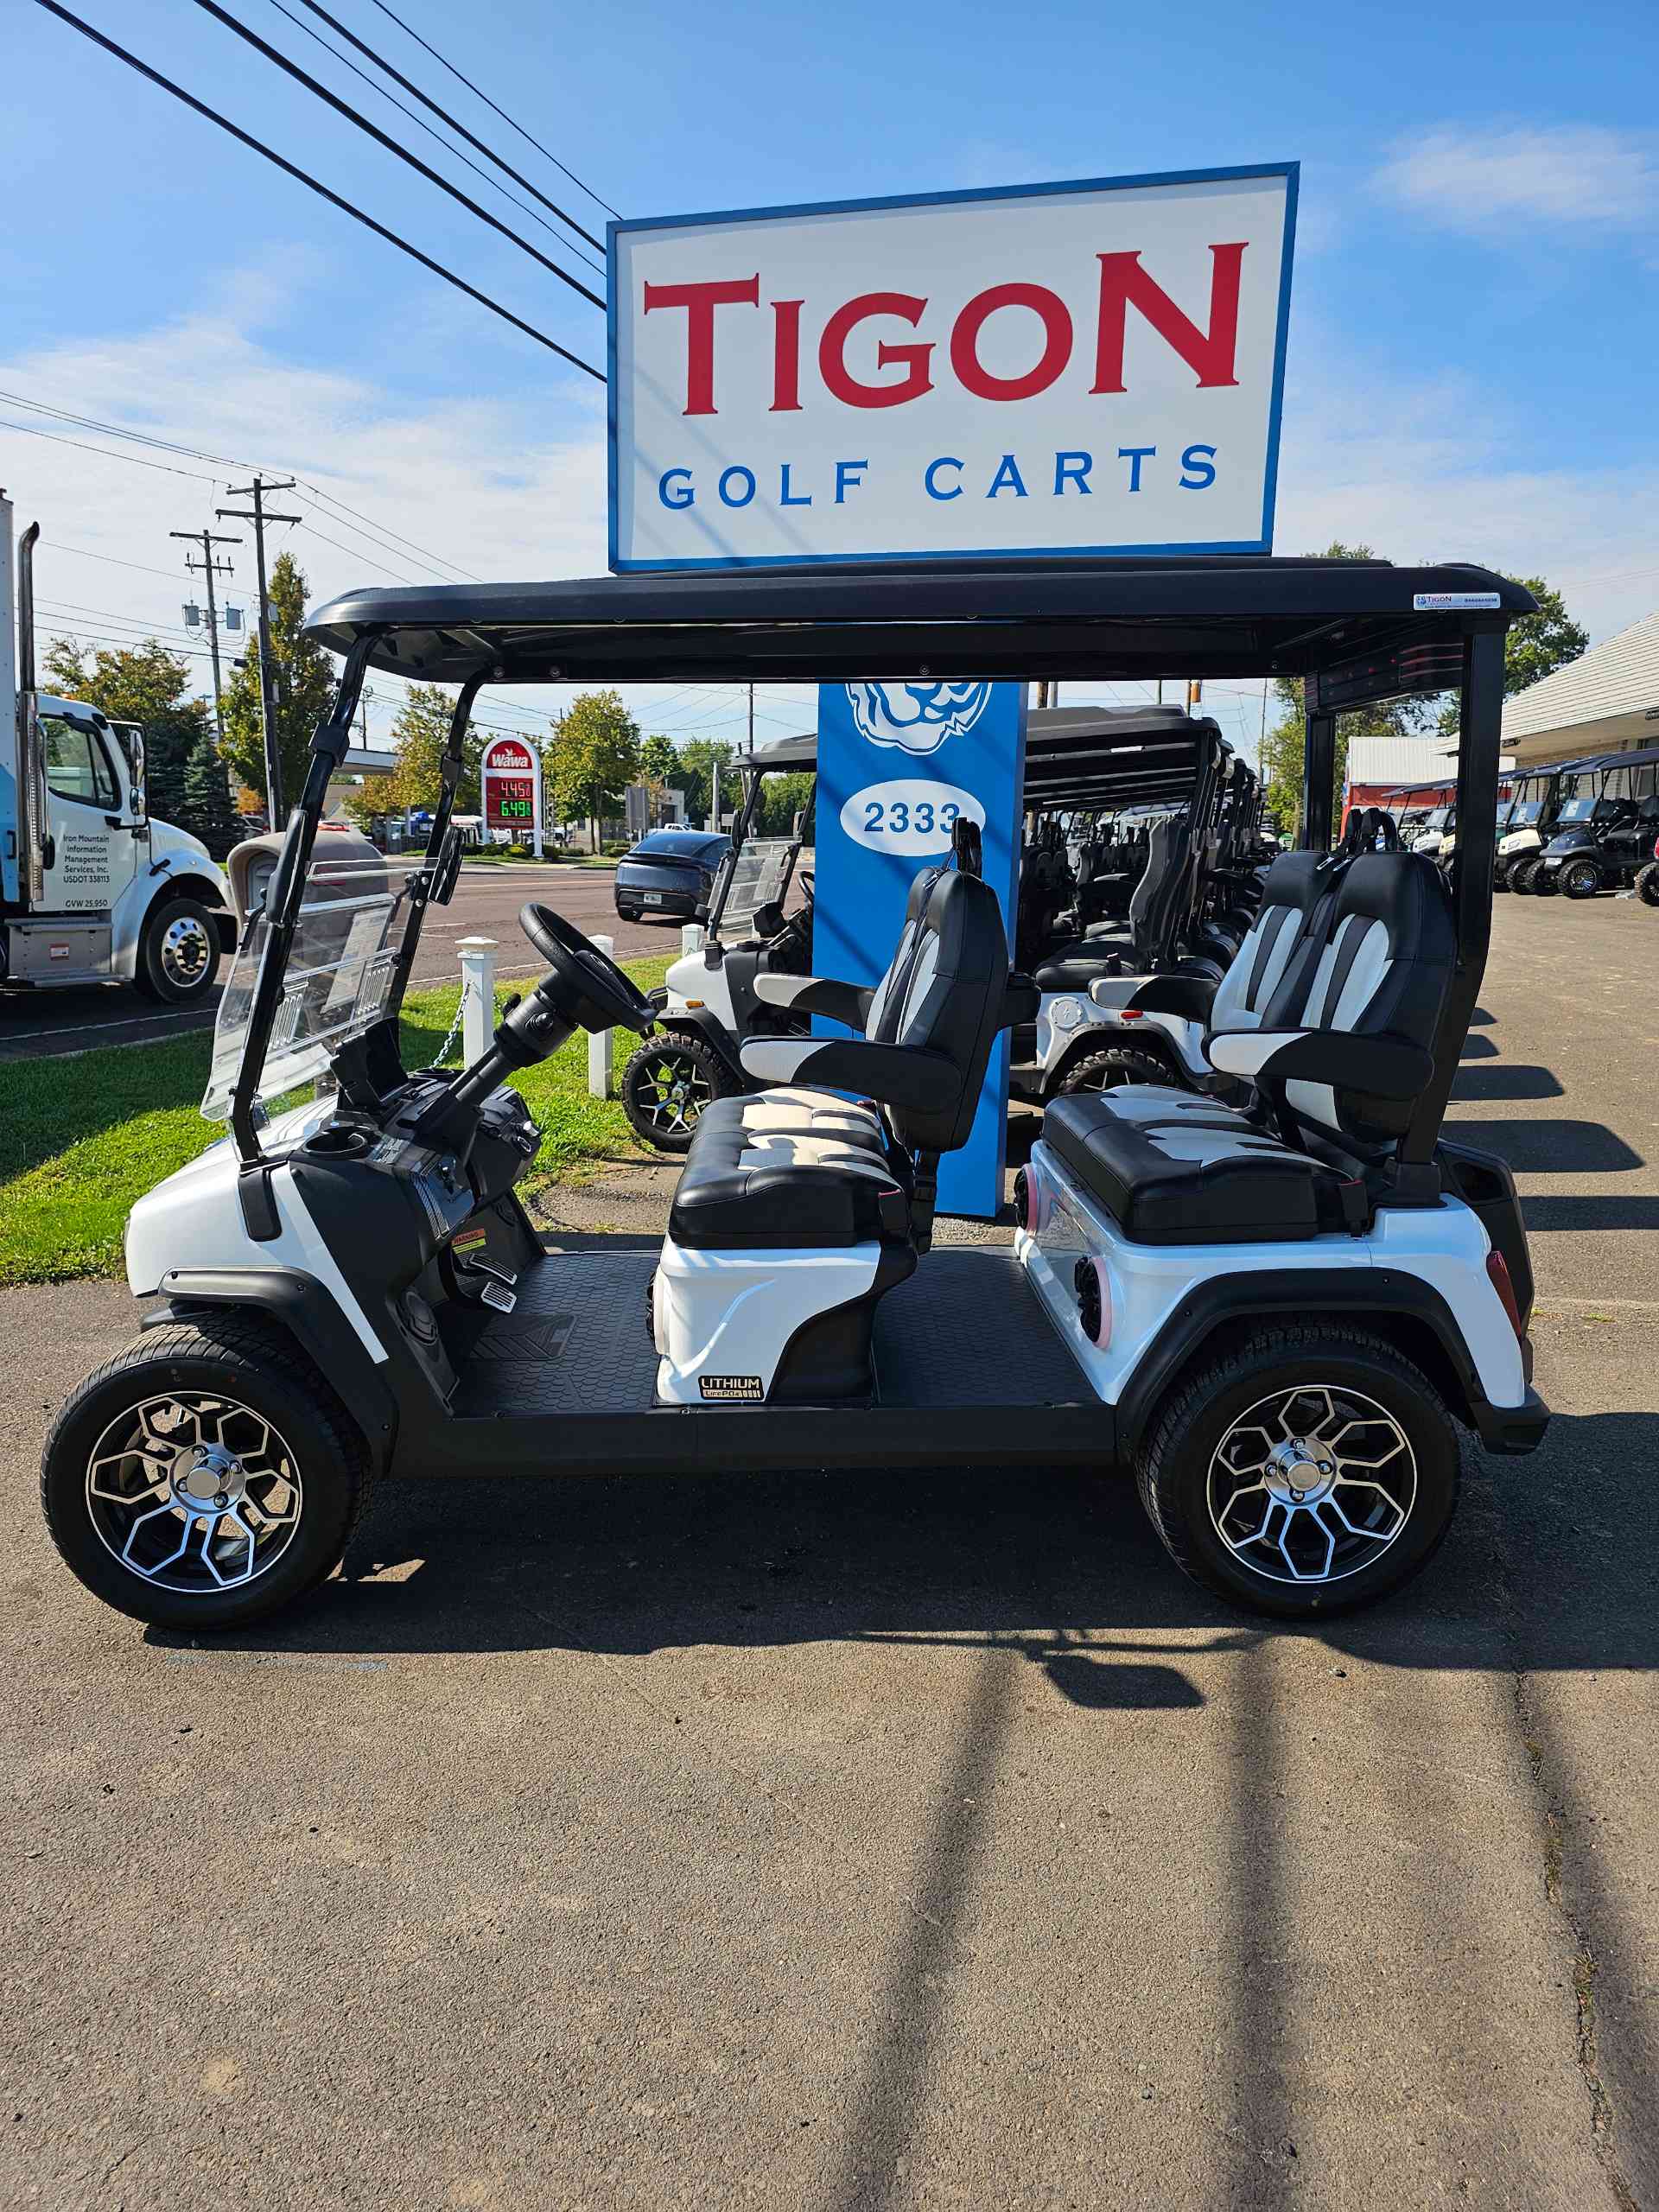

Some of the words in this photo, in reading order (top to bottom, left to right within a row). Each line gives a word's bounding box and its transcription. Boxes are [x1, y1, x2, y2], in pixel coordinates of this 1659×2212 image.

[645, 243, 1249, 415] TIGON
[658, 459, 868, 510] GOLF
[925, 445, 1217, 501] CARTS
[492, 753, 528, 767] Wawa
[864, 802, 960, 833] 2333
[65, 855, 108, 864] Management
[701, 1377, 760, 1389] LITHIUM
